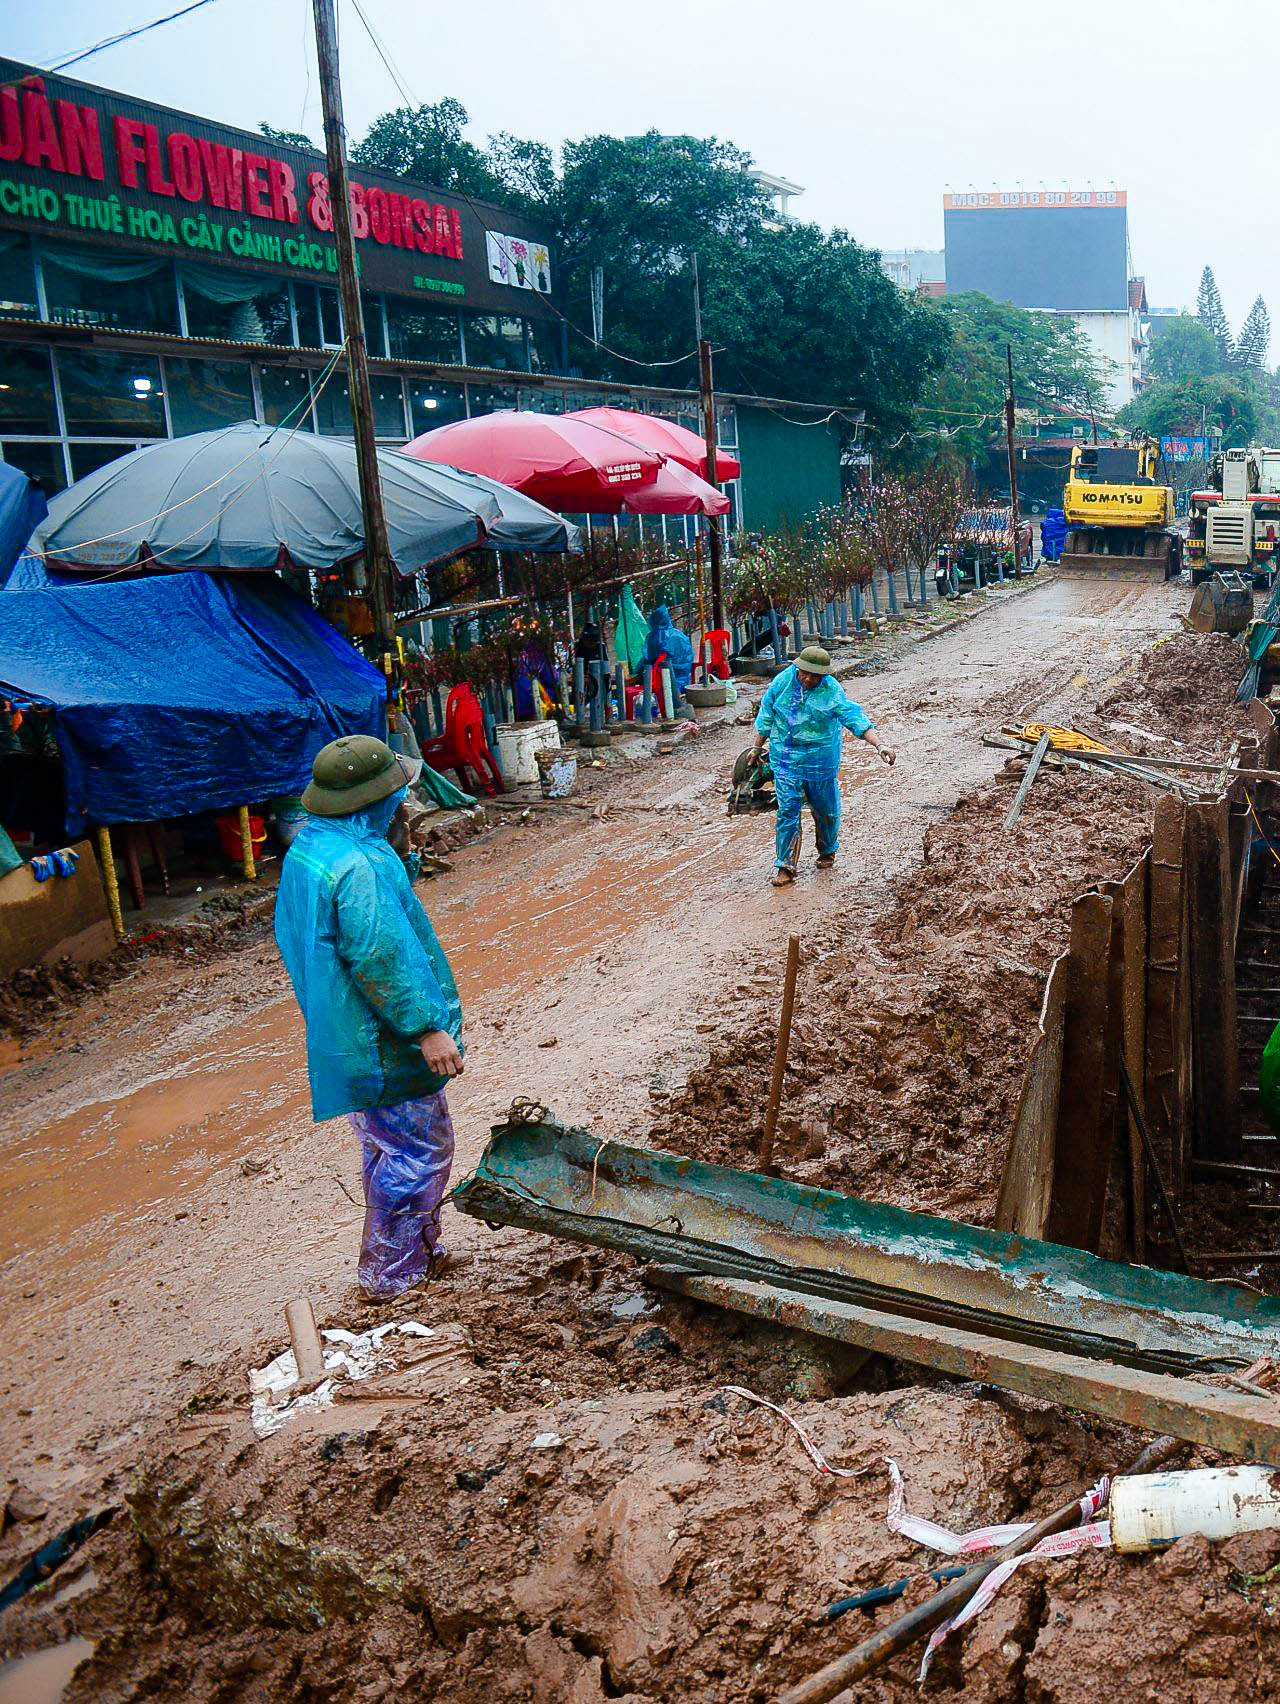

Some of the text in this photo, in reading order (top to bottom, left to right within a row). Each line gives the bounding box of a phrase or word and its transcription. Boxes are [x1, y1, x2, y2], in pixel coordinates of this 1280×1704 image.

[0, 179, 60, 221] CHO
[64, 194, 123, 233] THUÊ
[127, 206, 178, 244] HOA
[180, 213, 224, 251] CÂY
[227, 220, 283, 263] CẢNH
[283, 233, 323, 270] CÁC
[112, 115, 299, 225] FLOWER
[307, 171, 335, 232] &
[347, 180, 464, 260] BONSAI
[1082, 493, 1143, 504] KOMATSU
